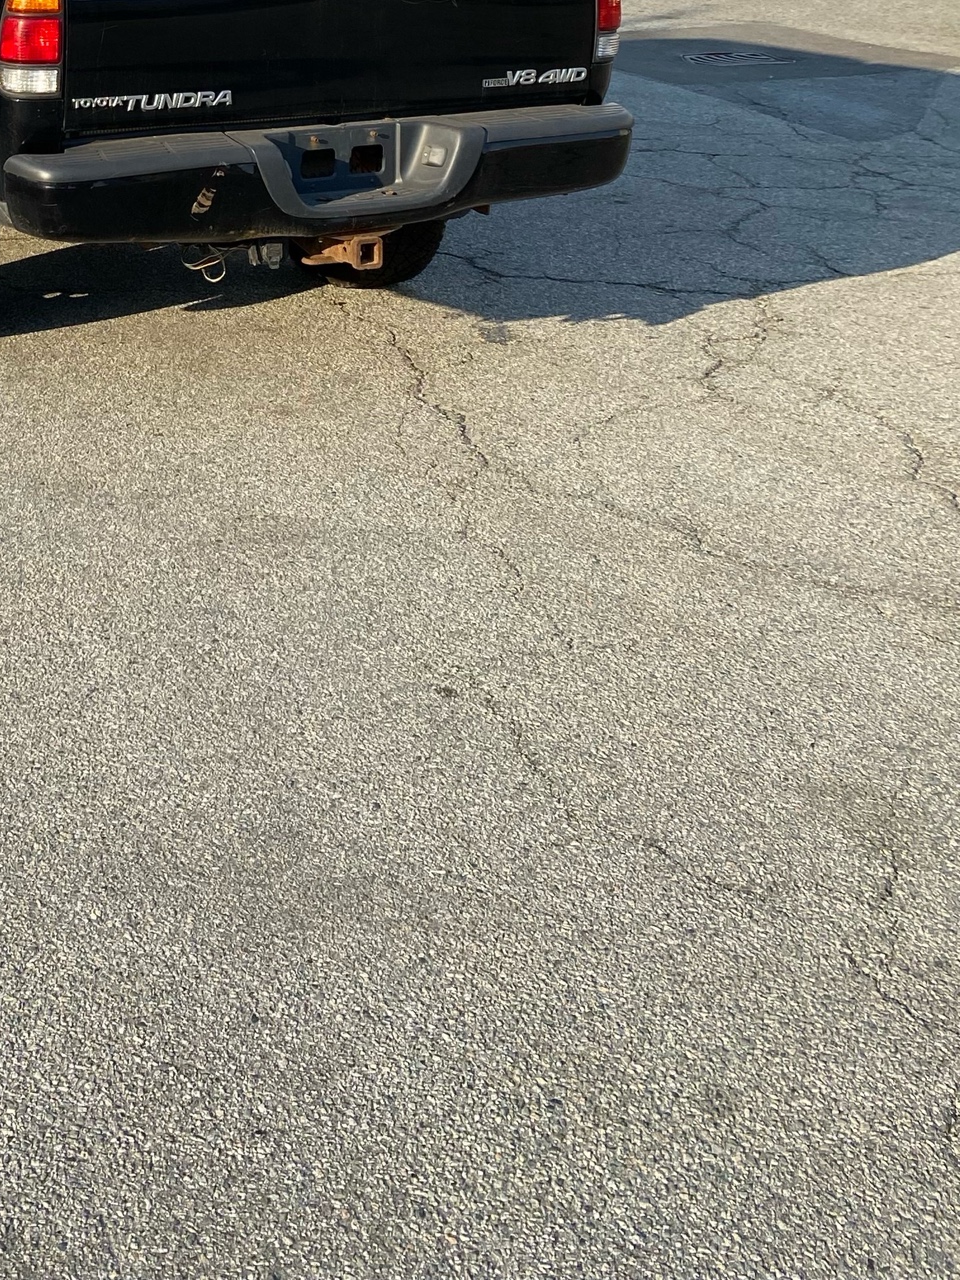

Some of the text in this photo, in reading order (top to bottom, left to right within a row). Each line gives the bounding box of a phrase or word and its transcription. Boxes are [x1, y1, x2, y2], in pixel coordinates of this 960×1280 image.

[507, 69, 537, 86] V8
[538, 67, 587, 84] 4WD
[72, 90, 233, 112] TOYOTA TUNDRA
